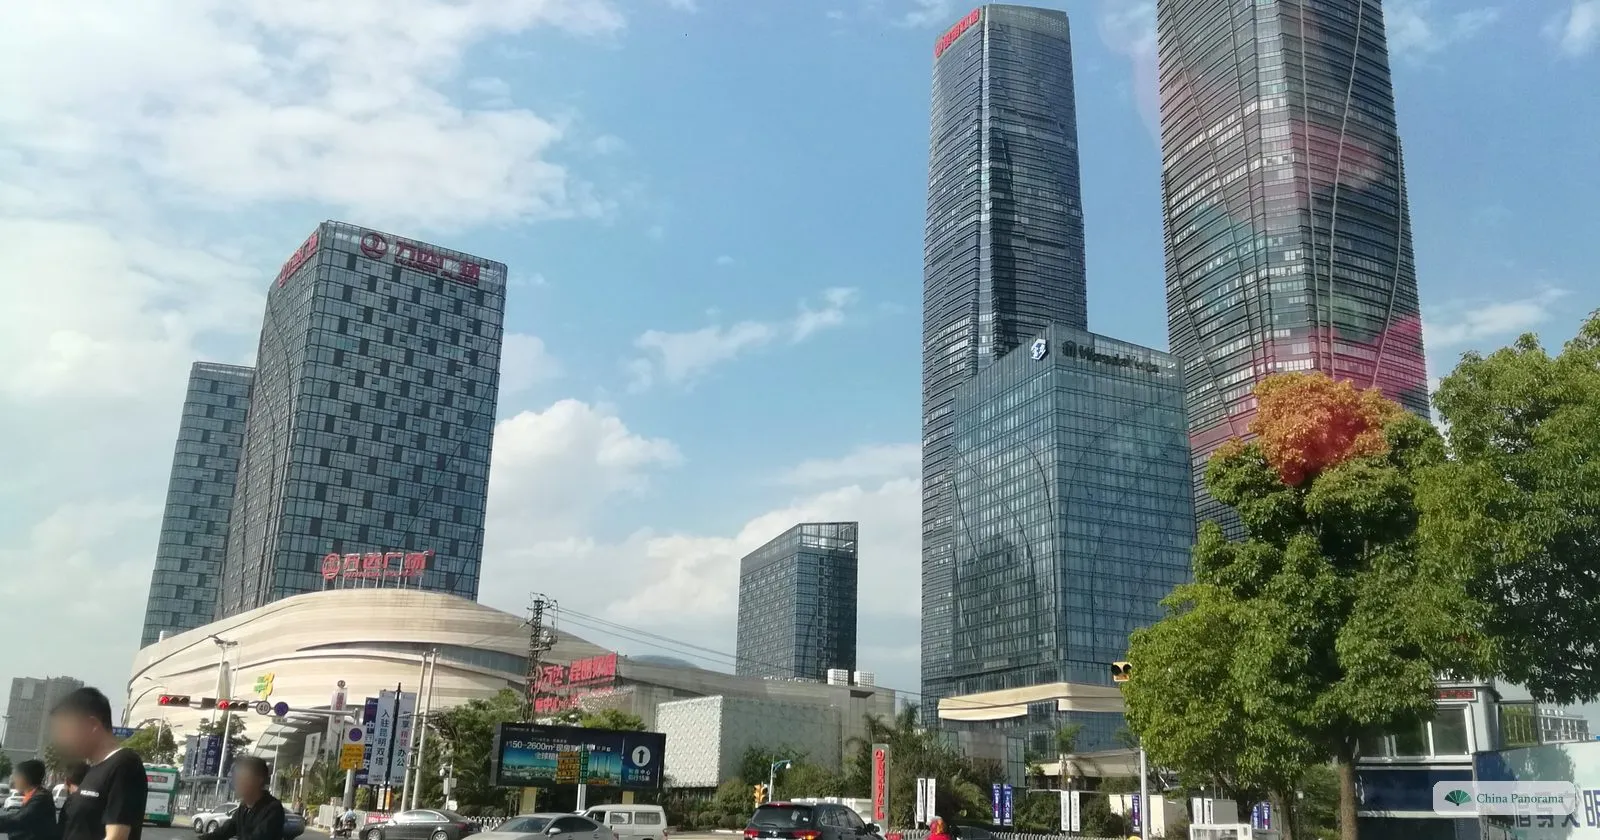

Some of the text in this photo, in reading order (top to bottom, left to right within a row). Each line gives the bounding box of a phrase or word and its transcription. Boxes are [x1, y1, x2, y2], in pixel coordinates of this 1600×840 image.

[375, 709, 390, 766] 入驻昆明双塔
